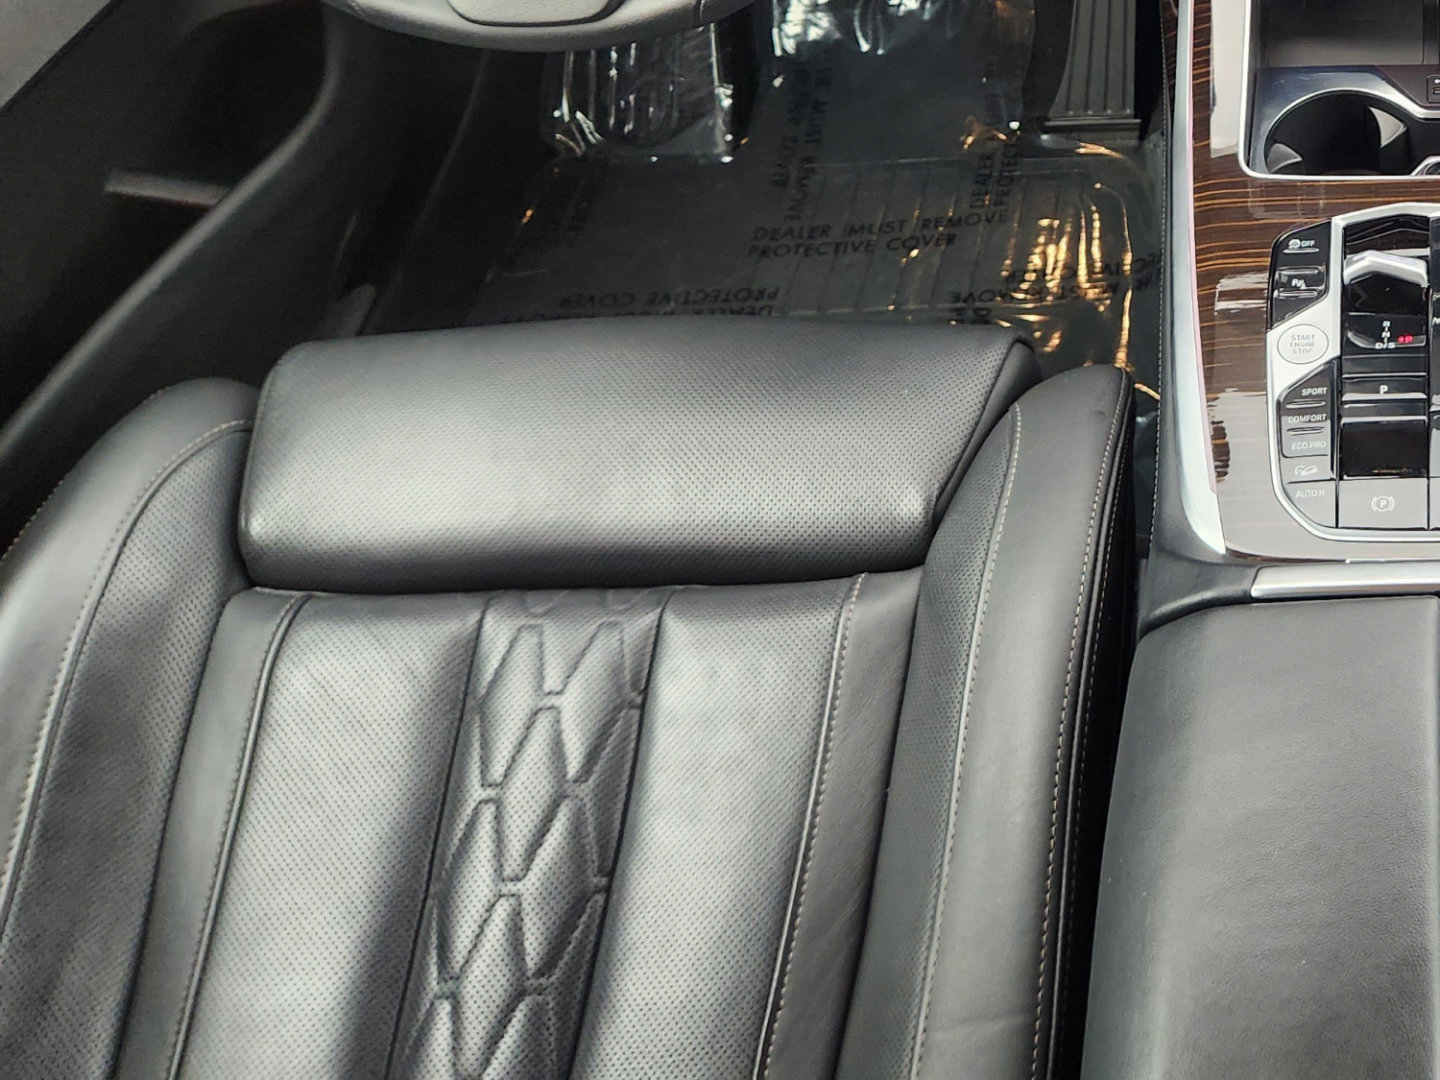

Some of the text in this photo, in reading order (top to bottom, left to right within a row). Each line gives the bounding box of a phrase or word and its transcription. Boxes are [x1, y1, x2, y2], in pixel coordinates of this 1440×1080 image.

[751, 210, 1011, 242] DEALER MUST REMOVE
[747, 232, 957, 258] PROTECTIVE COVER
[1301, 387, 1328, 396] SPORT
[1379, 384, 1389, 395] P
[1288, 414, 1327, 423] COMFORT
[1291, 440, 1326, 450] ECO PRO
[1295, 489, 1326, 498] AUTO H
